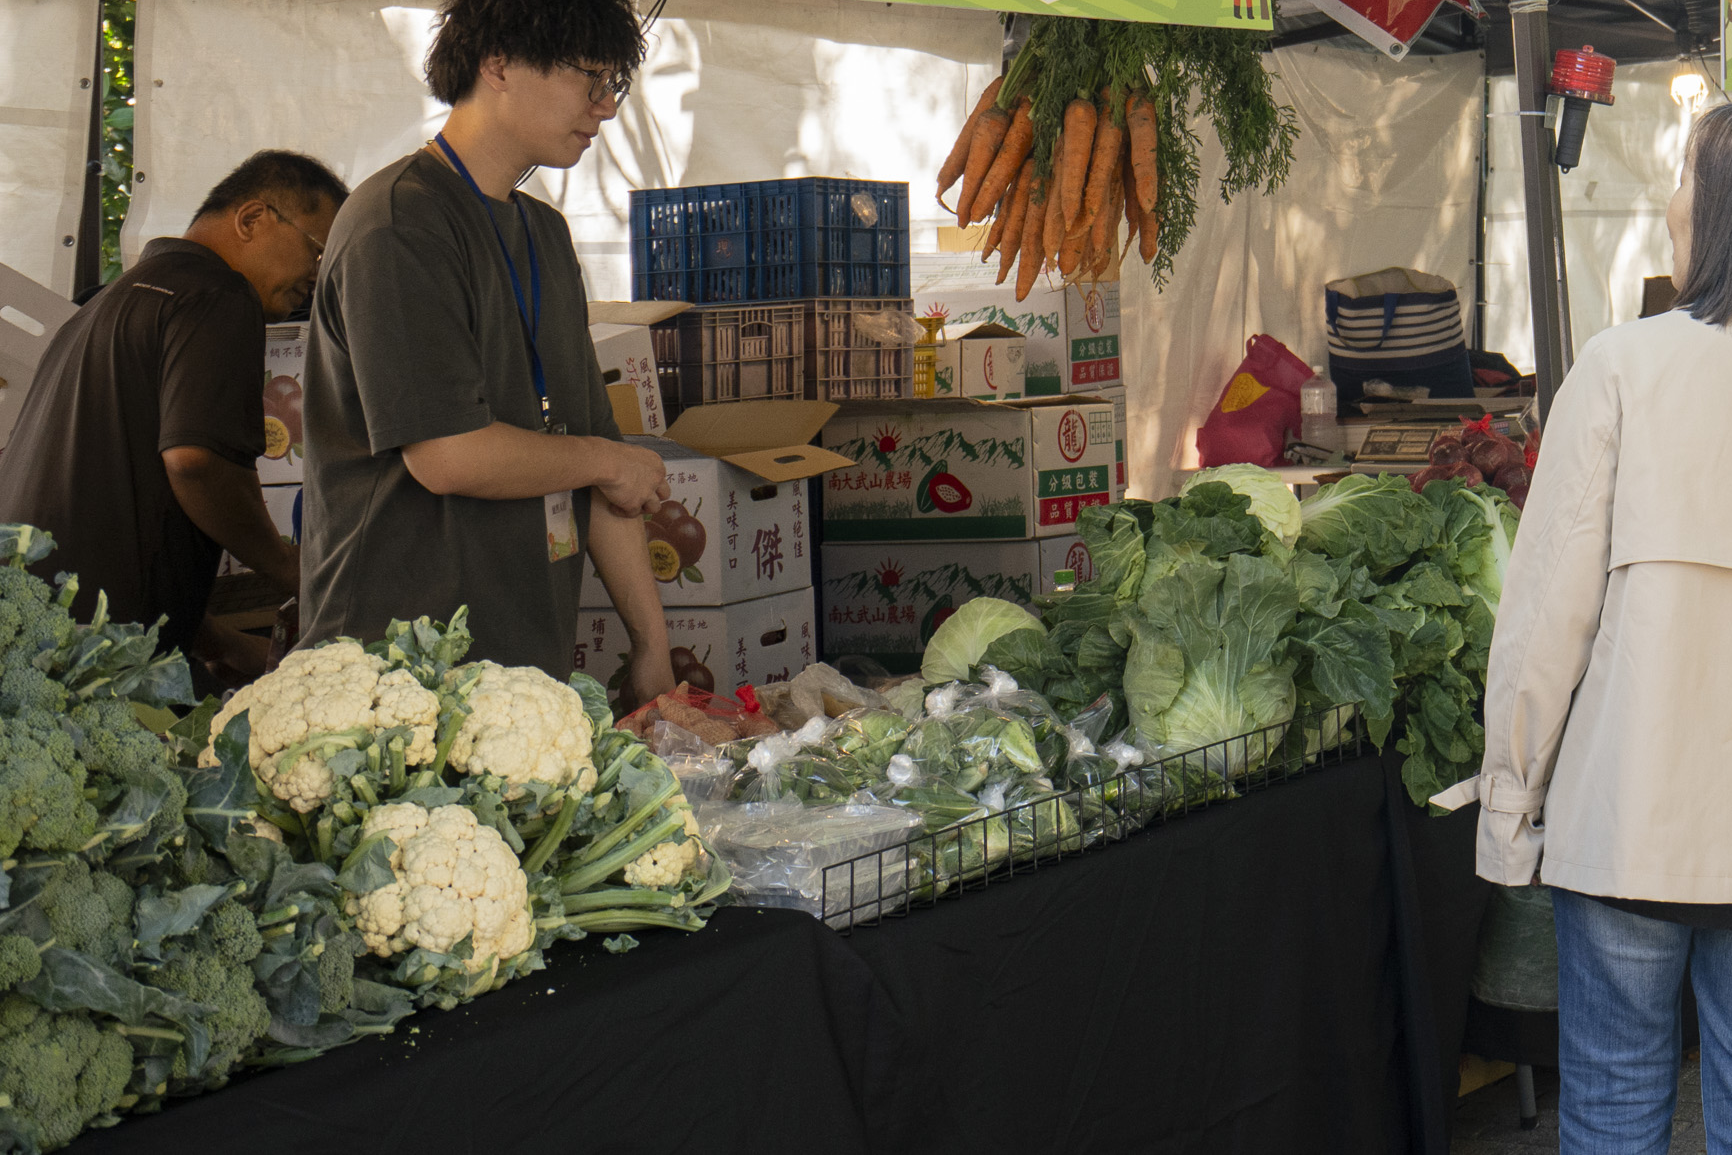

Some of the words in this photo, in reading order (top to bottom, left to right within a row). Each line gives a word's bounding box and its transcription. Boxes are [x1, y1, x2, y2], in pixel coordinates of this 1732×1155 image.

[1062, 418, 1081, 454] 龍
[828, 470, 912, 492] 南大武山農場
[1048, 470, 1099, 492] 分級包裝
[726, 491, 739, 569] 美味可口
[751, 523, 784, 581] 傑
[828, 605, 916, 625] 南大武山農場
[591, 618, 605, 652] 埔里
[801, 621, 811, 672] 風味
